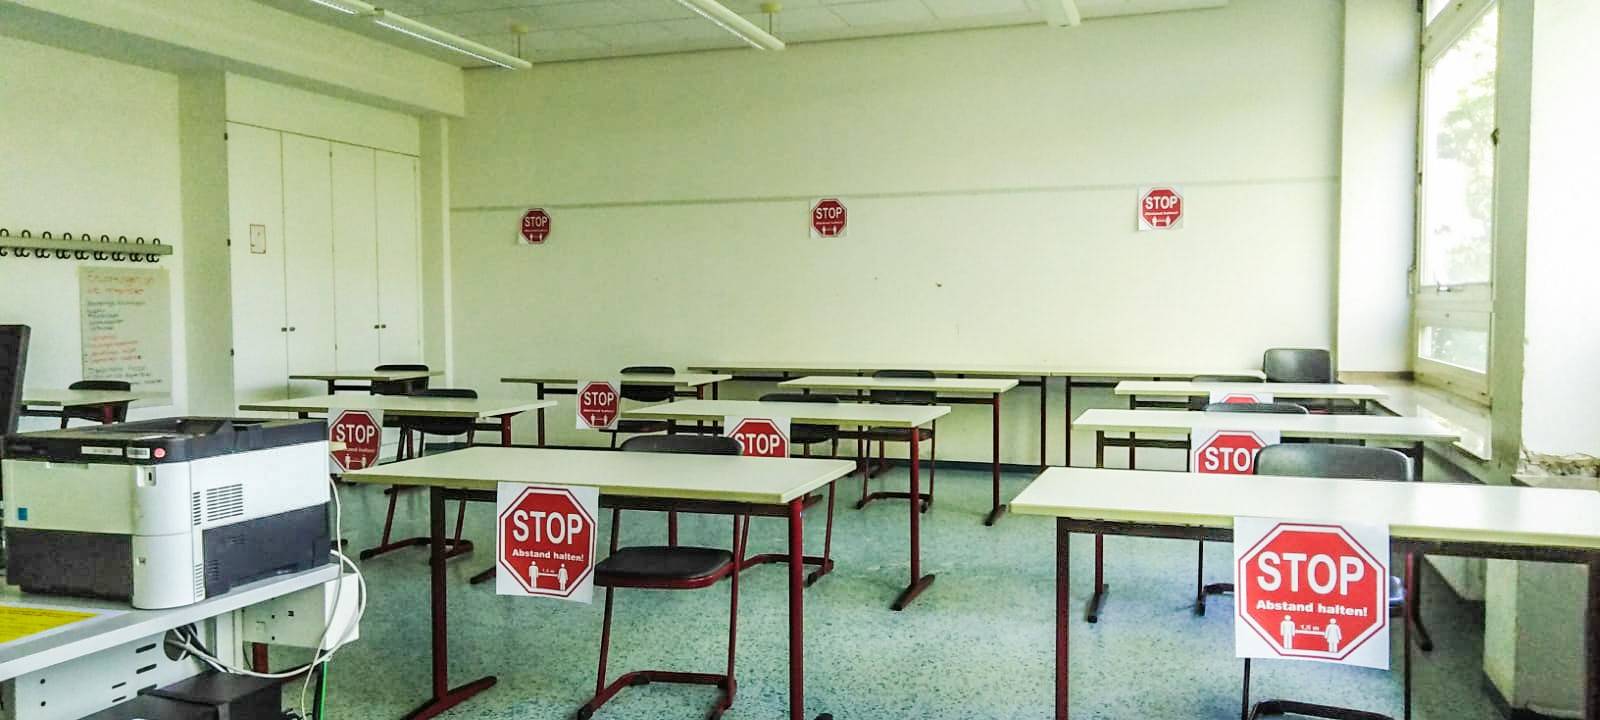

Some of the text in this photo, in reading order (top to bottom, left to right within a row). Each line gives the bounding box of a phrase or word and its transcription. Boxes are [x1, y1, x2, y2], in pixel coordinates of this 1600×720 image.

[1145, 196, 1178, 209] STOP
[815, 207, 842, 219] STOP
[524, 216, 548, 227] STOP
[583, 391, 614, 406] STOP
[336, 423, 375, 444] STOP
[512, 509, 583, 545] STOP
[512, 548, 584, 562] Abstand halten!
[1257, 551, 1365, 596] STOP
[1256, 599, 1368, 617] Abstand halten!
